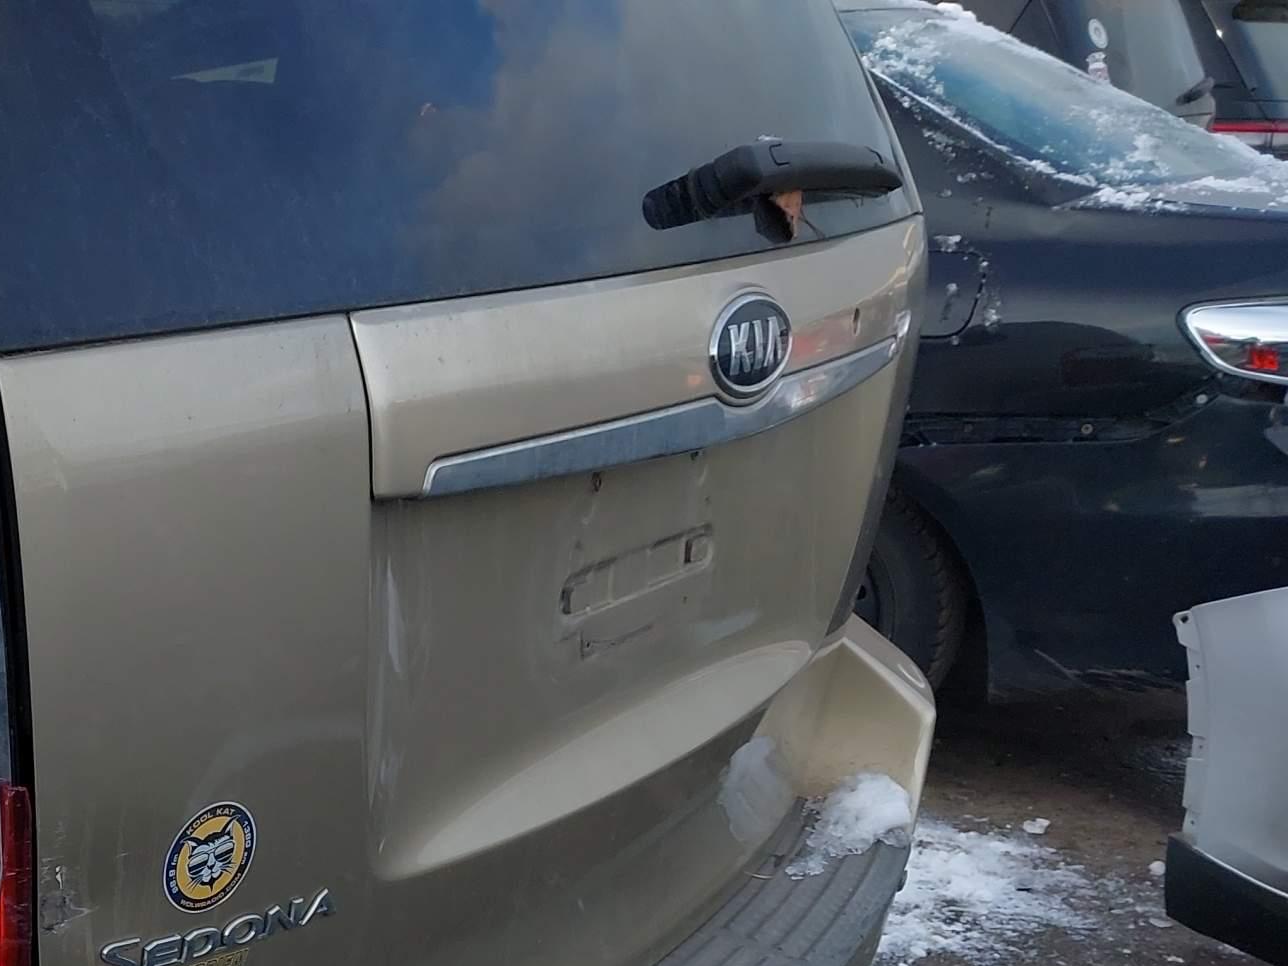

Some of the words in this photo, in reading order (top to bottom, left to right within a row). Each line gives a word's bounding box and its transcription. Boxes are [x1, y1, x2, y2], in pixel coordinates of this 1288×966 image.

[727, 316, 787, 376] KIA
[186, 811, 215, 836] KOOL
[215, 807, 236, 817] KAT
[242, 820, 252, 849] 1380
[170, 853, 179, 866] fm
